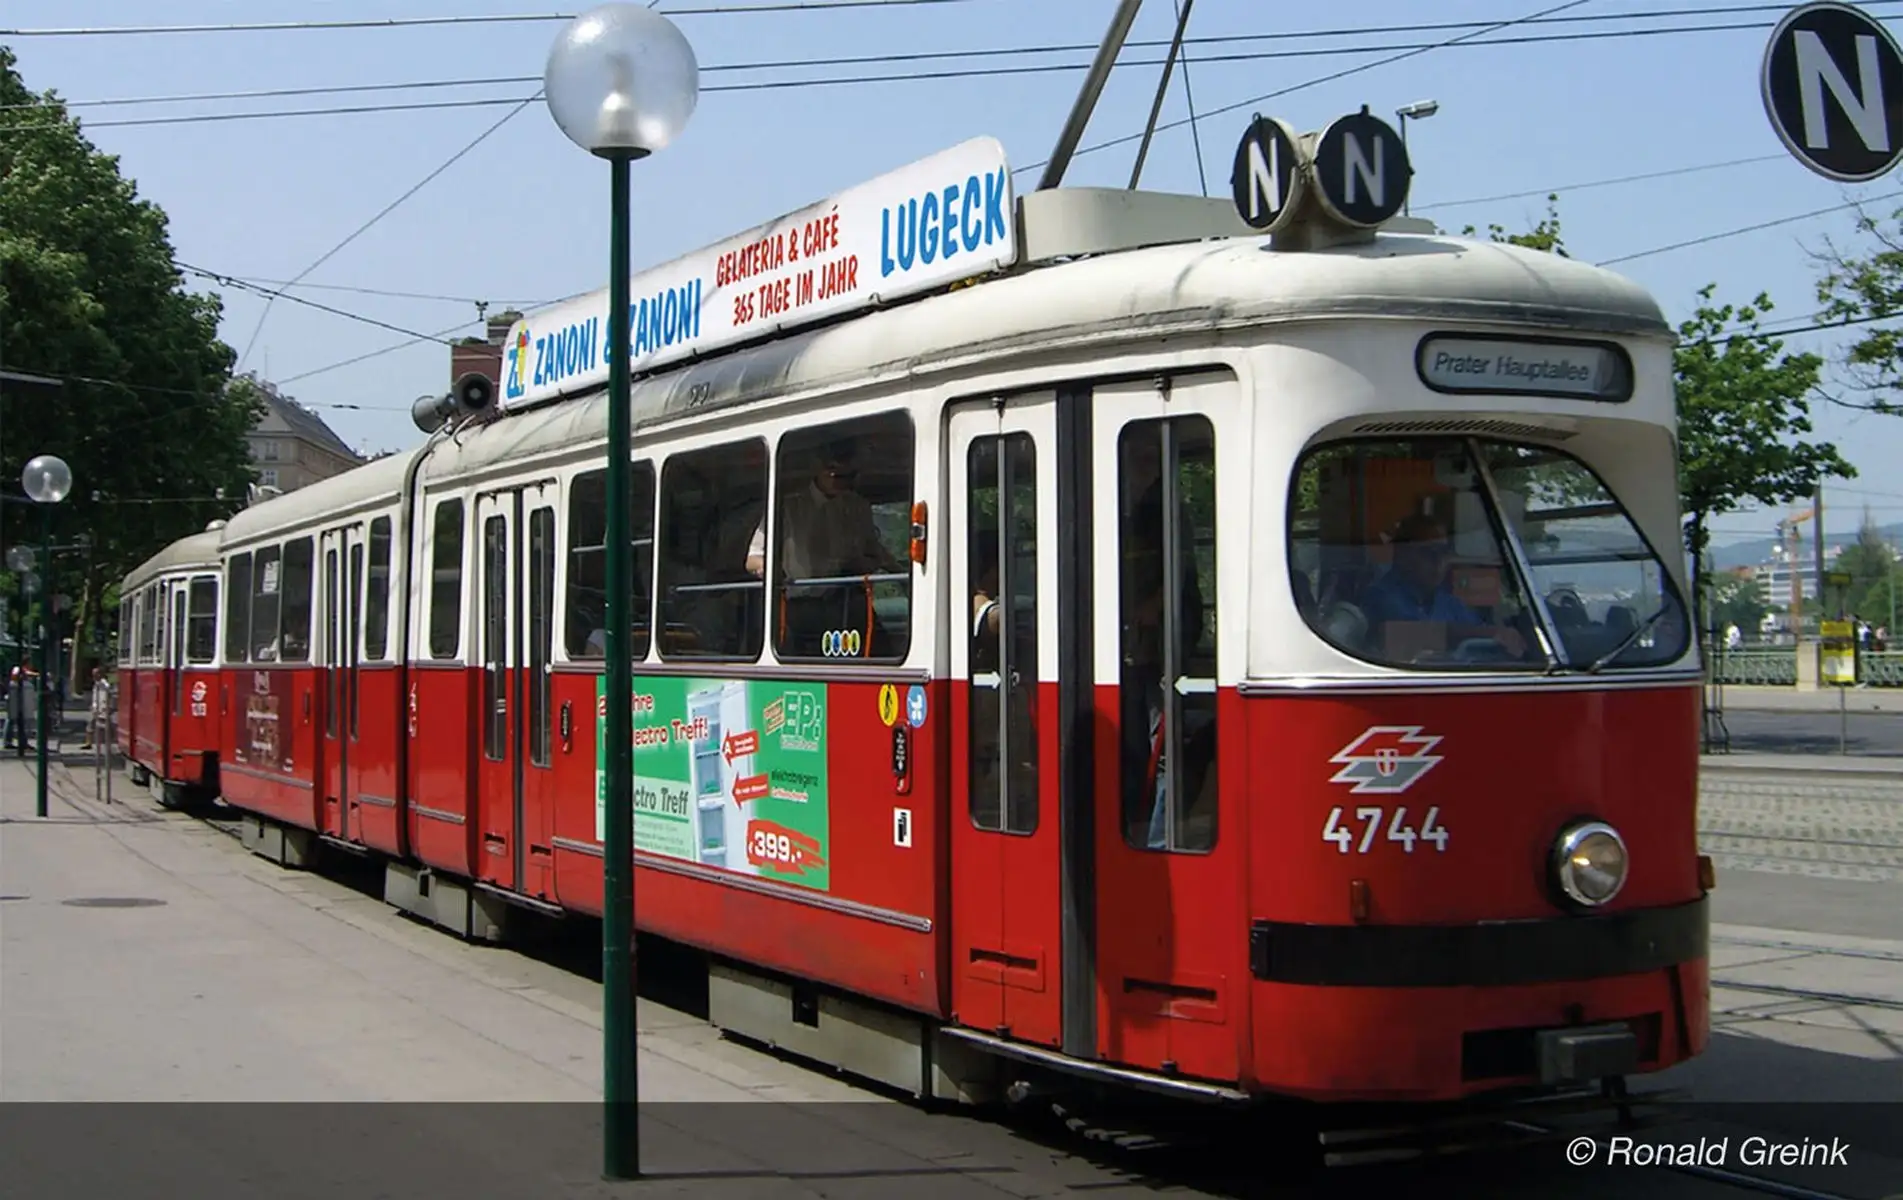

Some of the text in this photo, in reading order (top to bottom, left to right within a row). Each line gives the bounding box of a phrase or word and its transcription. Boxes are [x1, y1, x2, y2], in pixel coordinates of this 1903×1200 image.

[1793, 30, 1890, 152] N
[1249, 138, 1281, 219] N
[1343, 131, 1385, 208] N
[716, 204, 839, 288] GELATERIA & CAFÉ
[881, 164, 1006, 278] LUGECK
[733, 254, 858, 327] 365 TAGE IM JAHR
[534, 317, 598, 386] ZANONI
[1434, 352, 1590, 382] Prater Hauptallee
[672, 718, 709, 741] Treff!
[660, 786, 690, 816] Treff
[1322, 806, 1450, 853] 4744
